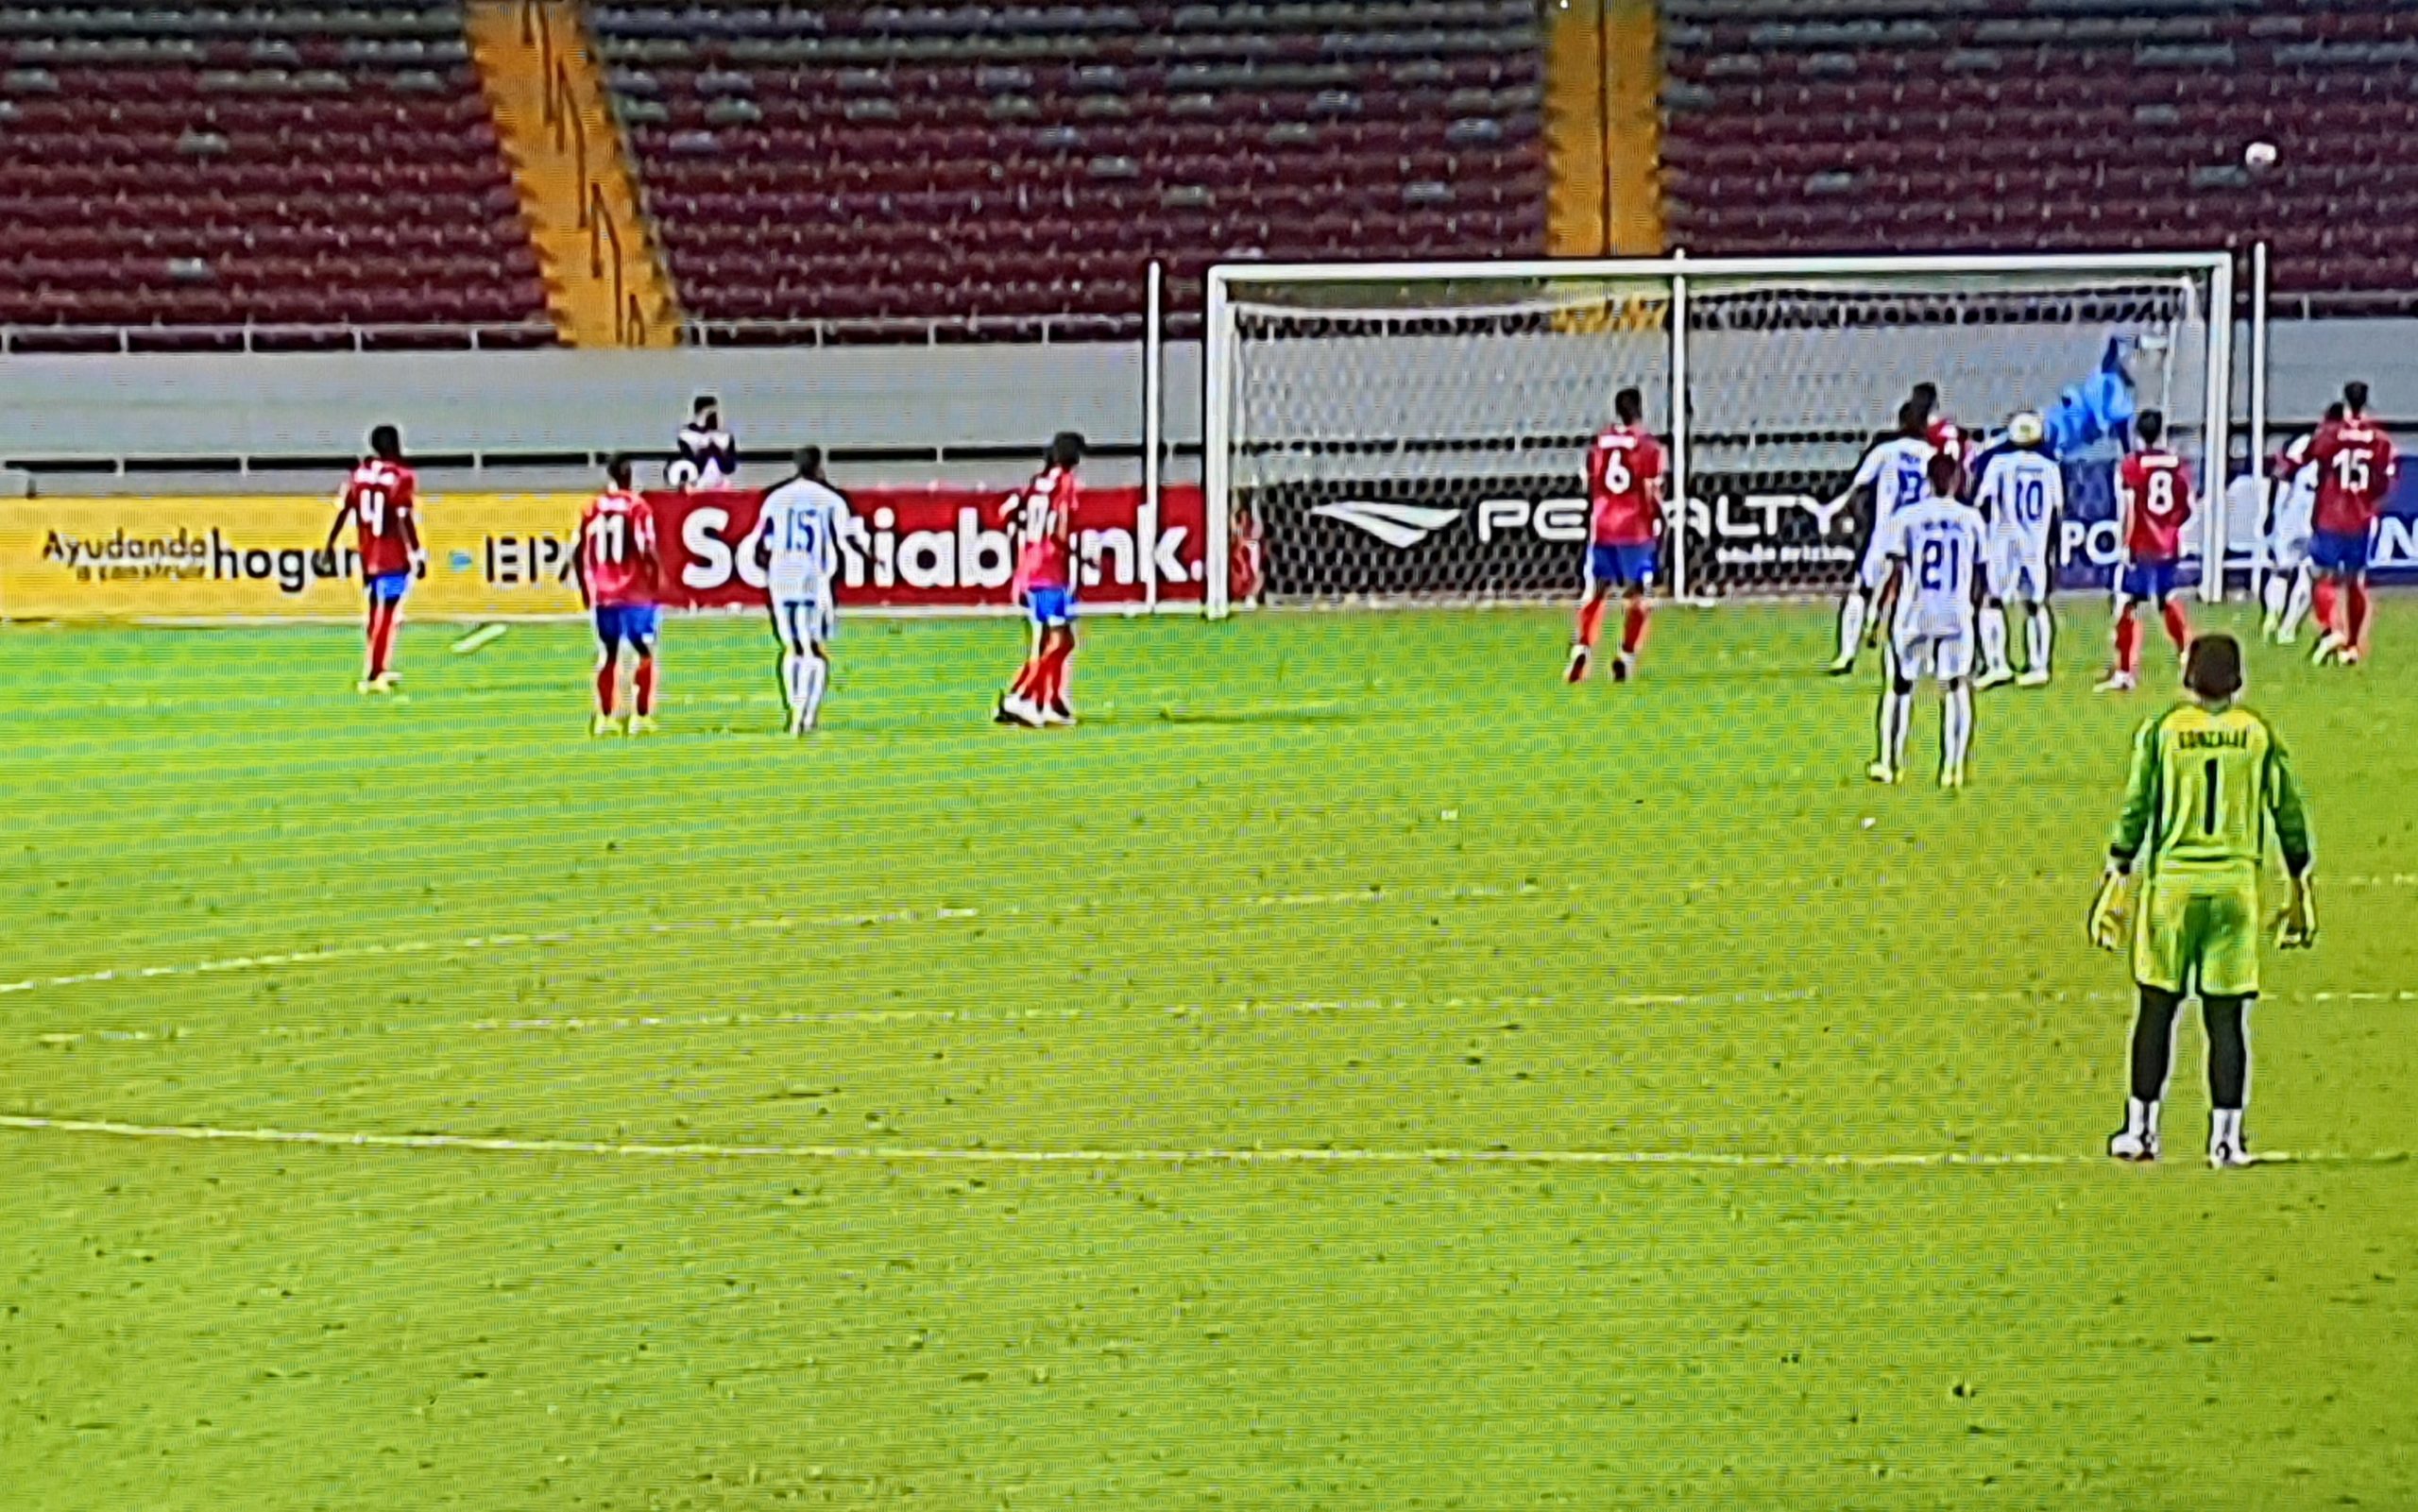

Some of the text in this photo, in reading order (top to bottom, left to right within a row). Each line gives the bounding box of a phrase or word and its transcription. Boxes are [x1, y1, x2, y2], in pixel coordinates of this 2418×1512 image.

[1604, 449, 1631, 495] 6
[2147, 470, 2173, 516] 8
[2331, 448, 2375, 496] 15
[359, 488, 385, 537] 4
[2015, 479, 2044, 521] 10
[43, 527, 206, 568] Ayudando
[591, 514, 624, 565] 11
[785, 506, 815, 552] 15
[213, 526, 363, 592] hogar
[1920, 538, 1960, 591] 21
[2204, 757, 2219, 836] 1
